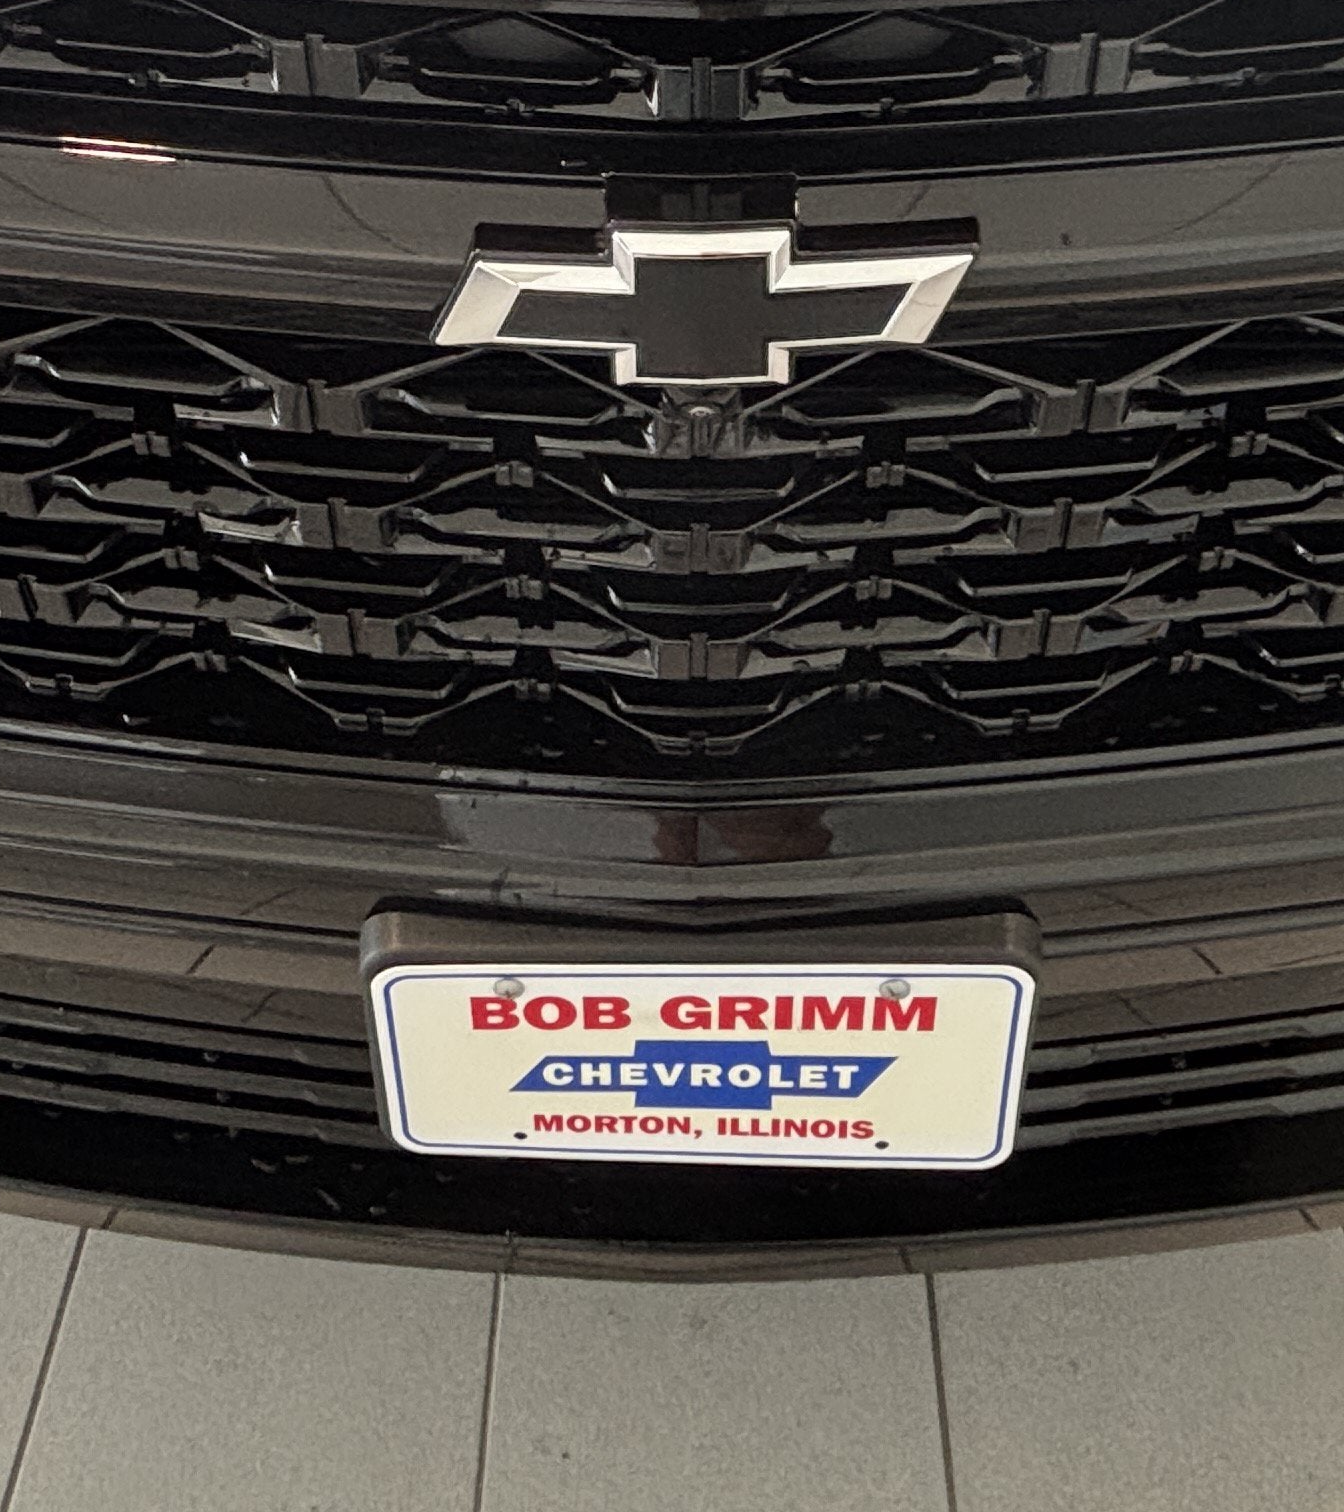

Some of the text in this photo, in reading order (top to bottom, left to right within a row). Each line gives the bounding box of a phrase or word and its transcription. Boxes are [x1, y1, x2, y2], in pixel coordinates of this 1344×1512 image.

[470, 995, 938, 1032] BOB GRIMM
[543, 1062, 859, 1089] CHEVROLET
[534, 1114, 874, 1139] MORTON, ILLINOIS
